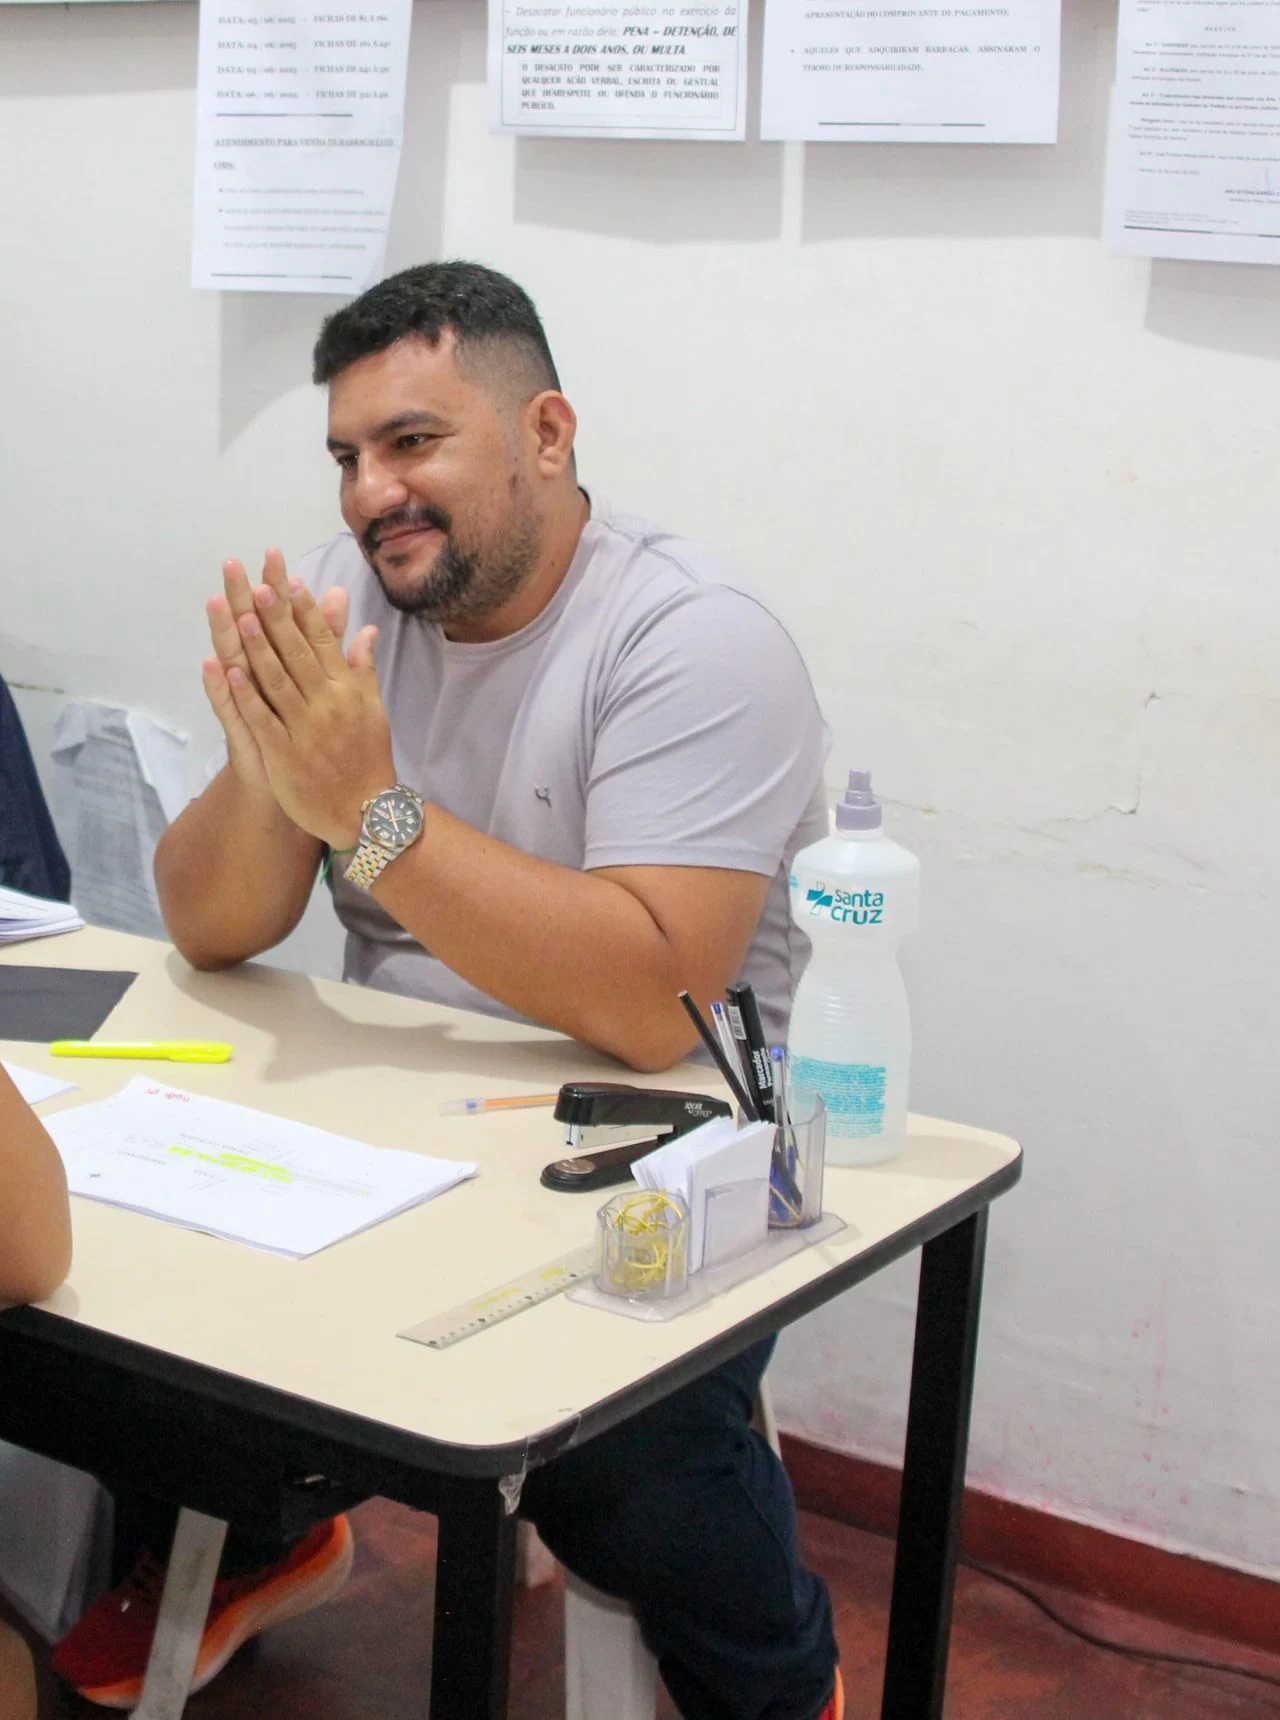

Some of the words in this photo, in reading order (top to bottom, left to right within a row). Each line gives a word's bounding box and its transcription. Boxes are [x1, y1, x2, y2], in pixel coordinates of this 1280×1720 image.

[516, 6, 561, 17] Desacatar
[565, 6, 618, 18] funcionário
[622, 7, 656, 19] público
[662, 8, 675, 16] no
[680, 7, 720, 16] exercício
[804, 10, 866, 19] APRESENTAÇÃO
[880, 9, 938, 18] COMPROVANTE
[942, 9, 951, 17] DE
[506, 26, 536, 38] função
[538, 28, 549, 37] ou
[551, 28, 565, 37] em
[568, 27, 594, 37] razão
[622, 26, 650, 37] PENA
[663, 24, 719, 38] DETENÇÃO,
[723, 26, 738, 37] DE
[506, 44, 528, 55] SEIS
[530, 44, 561, 55] MESES
[563, 44, 570, 55] A
[572, 44, 597, 55] DOIS
[600, 44, 629, 56] ANOS,
[632, 45, 647, 55] OU
[804, 46, 839, 55] AQUELES
[845, 46, 861, 55] QUE
[868, 46, 919, 55] ADQUIRIRAM
[926, 45, 971, 54] BARRACAS,
[978, 45, 1027, 54] ASSINARAM
[1033, 45, 1041, 53] O
[522, 64, 528, 72] O
[534, 64, 573, 72] DESACATO
[579, 64, 600, 72] PODE
[607, 64, 623, 72] SER
[629, 64, 696, 73] CARACTERIZADO
[703, 64, 720, 73] POR
[802, 64, 831, 72] TERMO
[832, 64, 841, 72] DE
[522, 76, 561, 85] QUALQUER
[566, 75, 586, 85] AÇÃO
[592, 76, 623, 85] VERBAL,
[628, 77, 661, 85] ESCRITA
[666, 77, 677, 85] OU
[684, 78, 718, 86] GESTUAL
[522, 89, 536, 98] QUE
[542, 89, 591, 98] DESRESPEITE
[598, 90, 609, 98] OU
[615, 90, 645, 98] OFENDA
[664, 90, 719, 100] FUNCIONÁRIO
[214, 138, 276, 147] ATENDIMENTO
[277, 138, 298, 147] PARA
[834, 888, 884, 907] santa
[831, 906, 883, 925] cruz
[752, 1050, 768, 1090] Marcador
